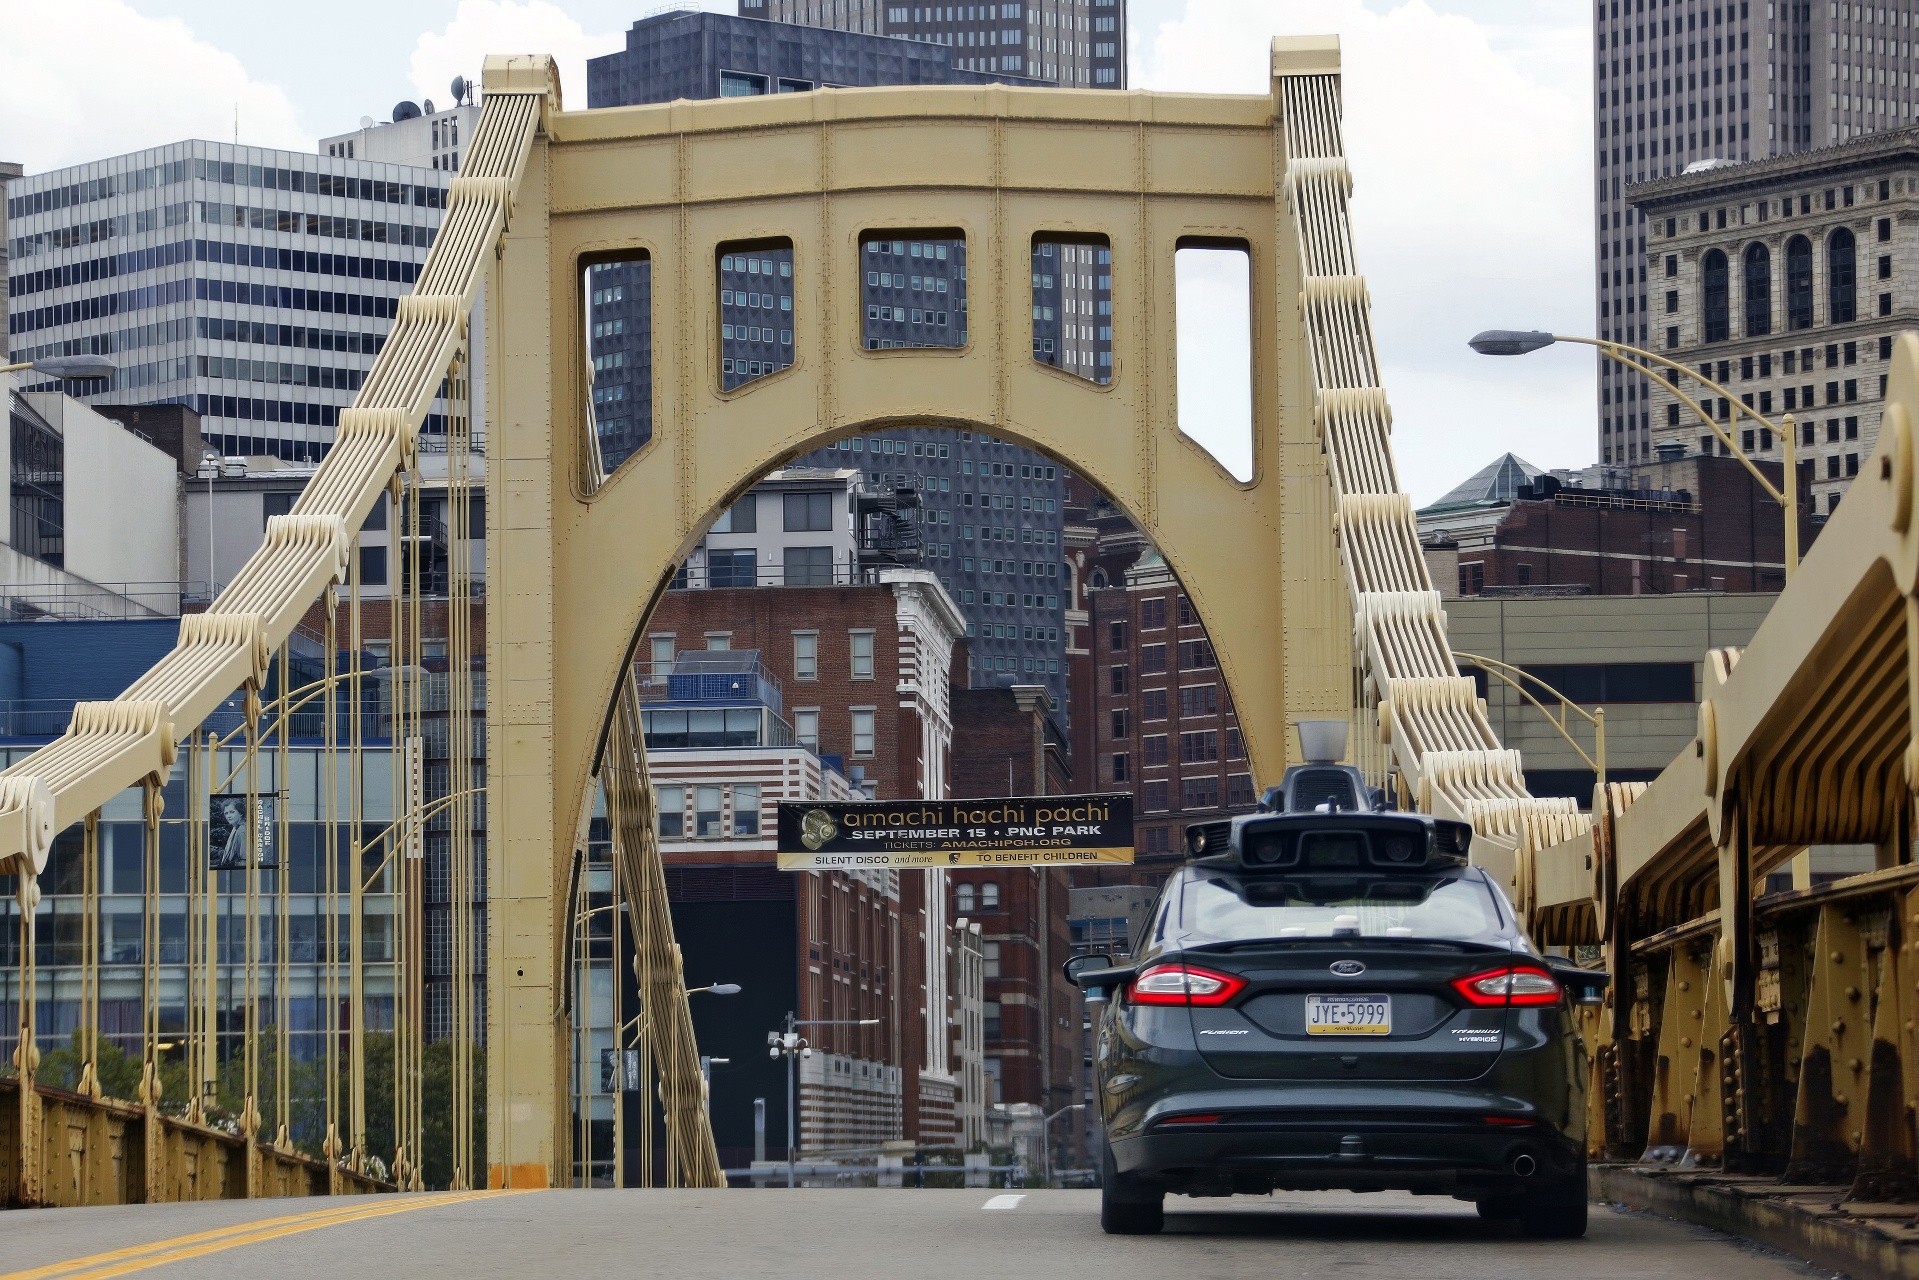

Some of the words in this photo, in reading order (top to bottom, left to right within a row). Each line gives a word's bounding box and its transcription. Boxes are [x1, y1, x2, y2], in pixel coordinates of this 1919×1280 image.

[843, 807, 943, 827] amachi
[953, 804, 1025, 824] hachi
[1035, 802, 1109, 827] pachi
[852, 828, 960, 839] SEPTEMBER
[966, 828, 986, 838] 15
[1007, 826, 1046, 837] PNC
[1052, 825, 1101, 836] PARK
[941, 838, 1072, 848] AMACHIPGH.ORG
[815, 856, 852, 865] SILENT
[856, 856, 889, 865] DISCO
[895, 854, 910, 863] and
[912, 855, 933, 863] more
[976, 854, 992, 862] TO
[995, 853, 1039, 862] BENEFIT
[1043, 852, 1098, 860] CHILDREN
